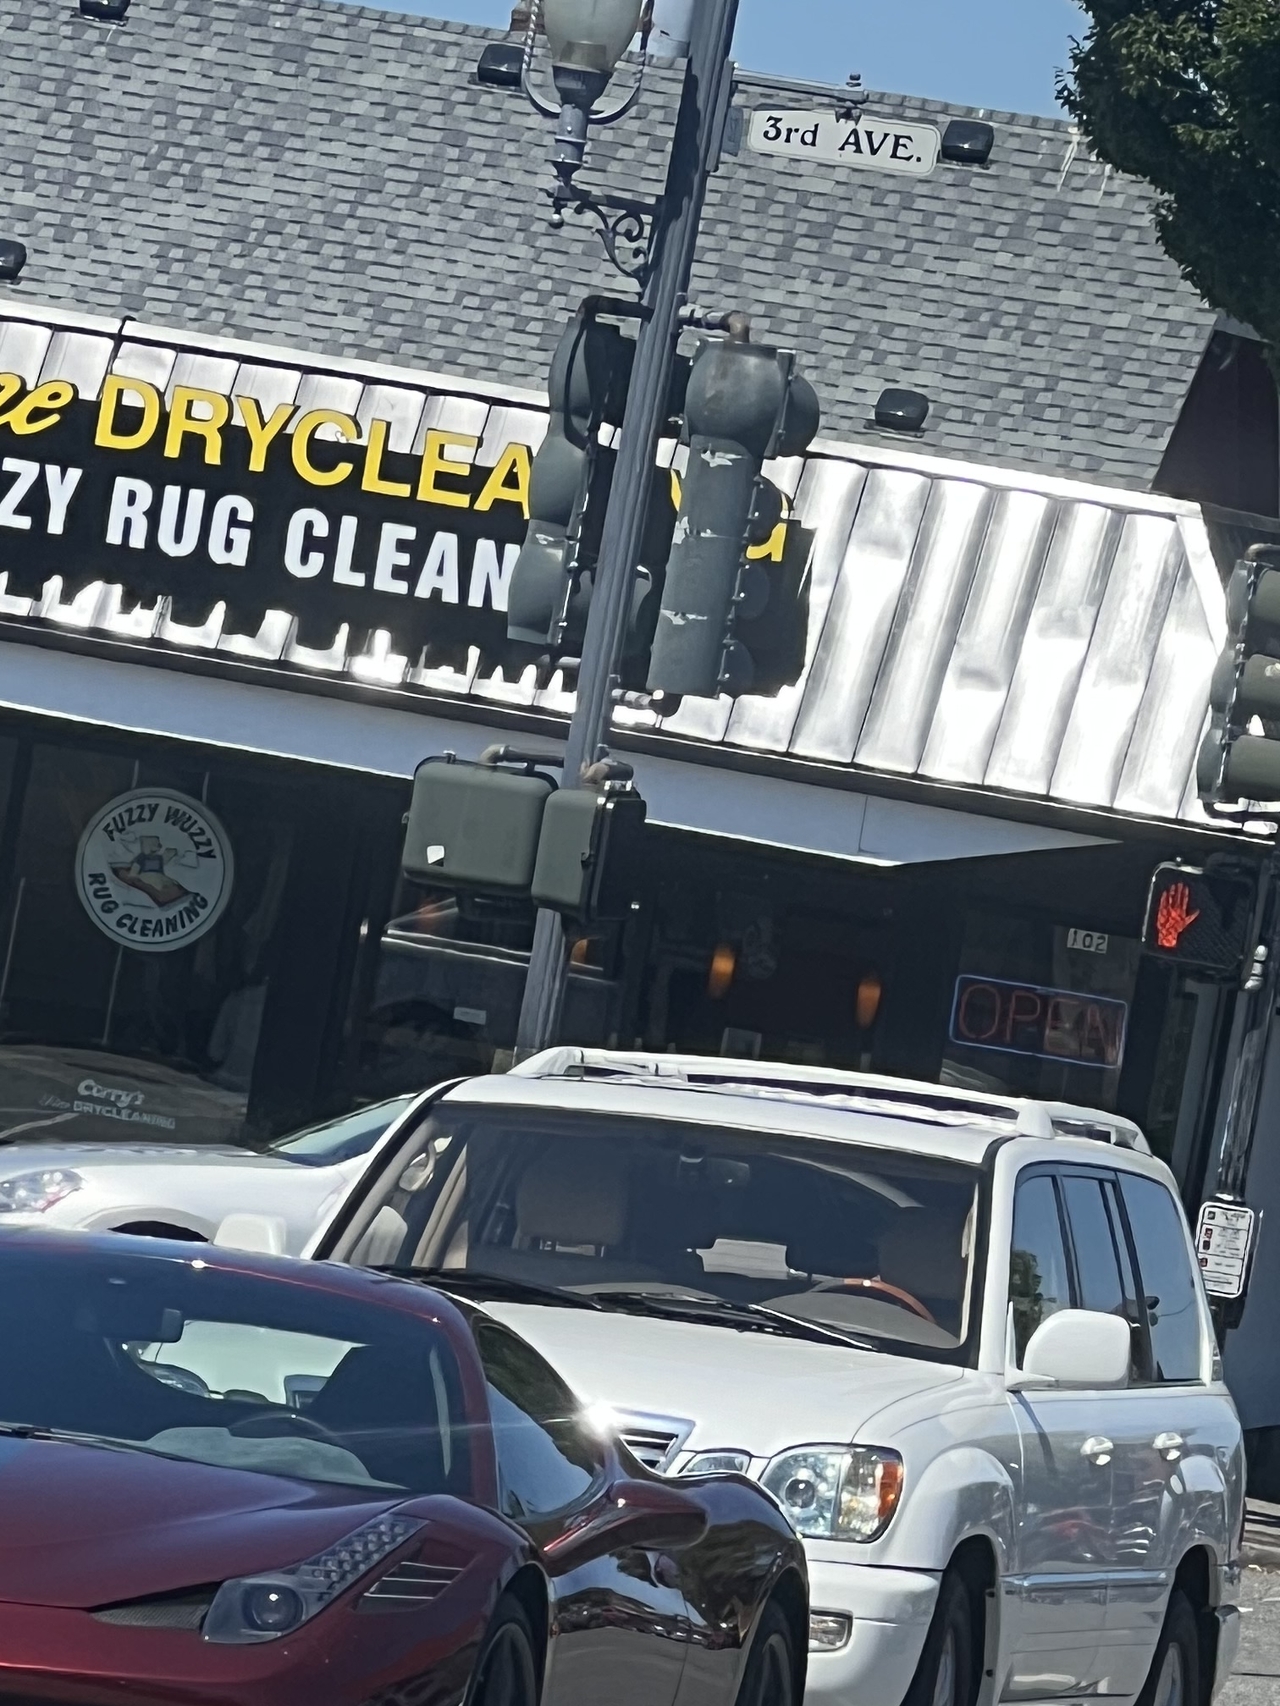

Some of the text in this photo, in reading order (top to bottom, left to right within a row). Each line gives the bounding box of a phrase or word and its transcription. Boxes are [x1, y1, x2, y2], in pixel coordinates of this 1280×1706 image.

[763, 115, 922, 163] 3rd AVE.
[106, 476, 253, 567] RUG
[102, 803, 217, 859] FUZZY WUZZY
[88, 872, 209, 938] RUG CLEANING
[1070, 928, 1107, 951] 102
[958, 984, 1121, 1063] OPEN
